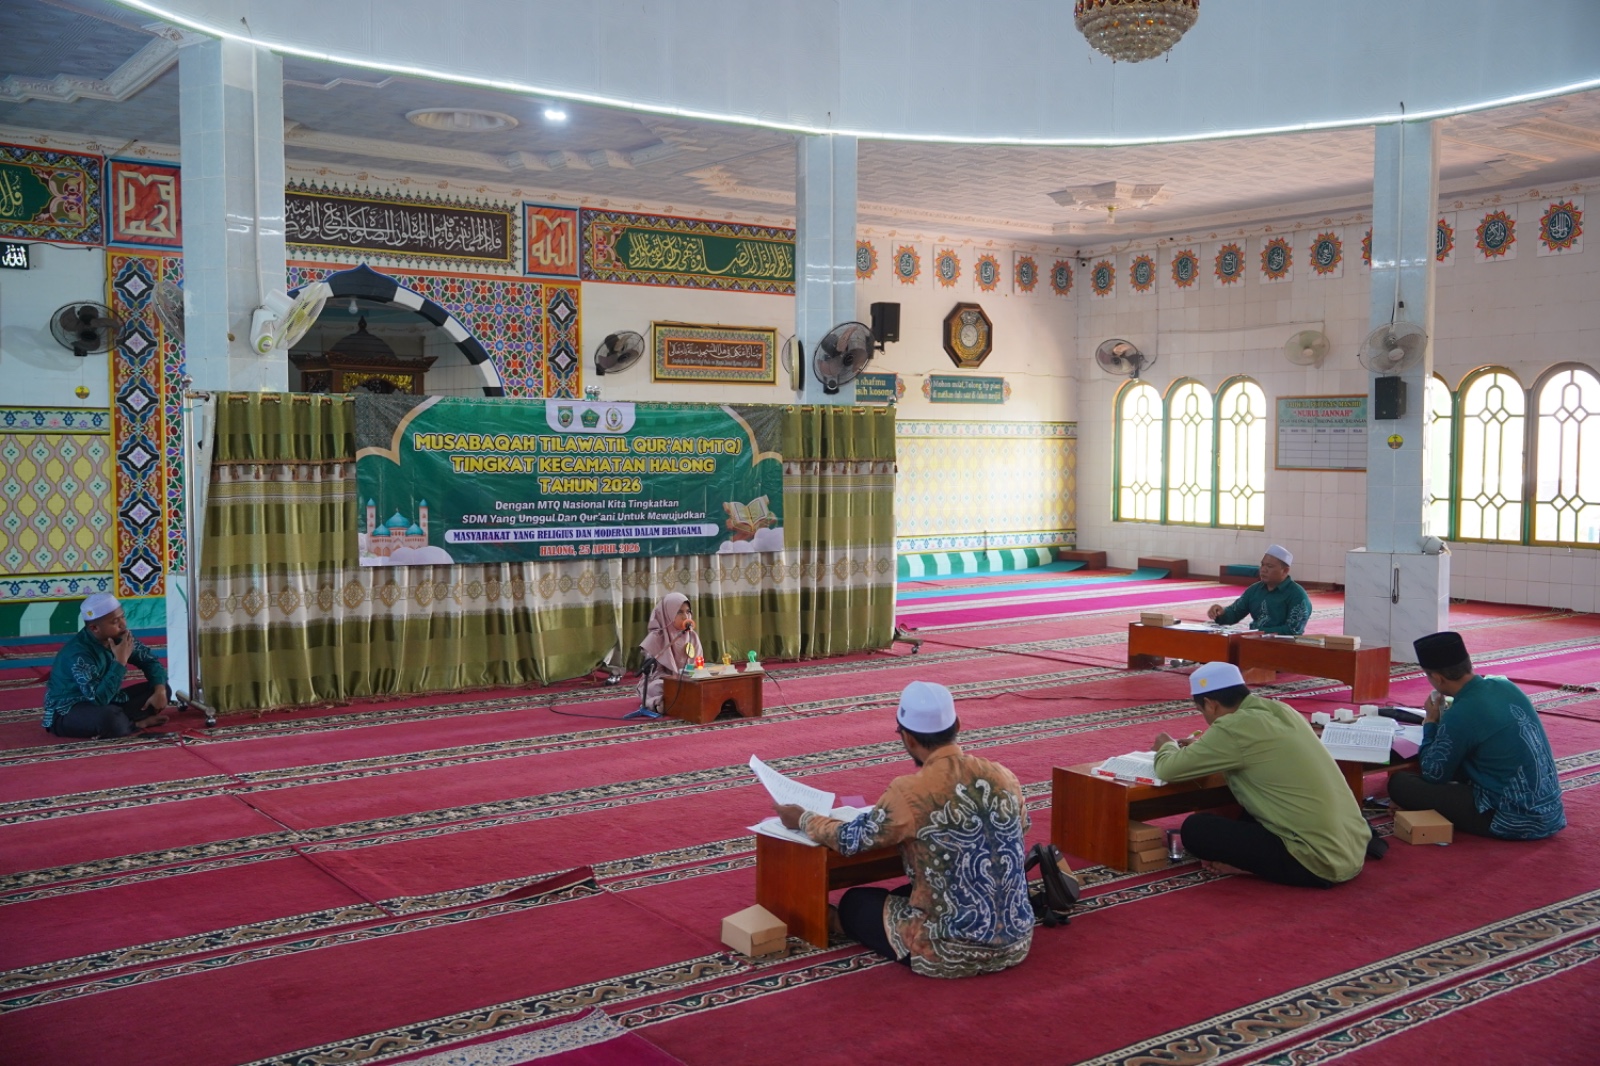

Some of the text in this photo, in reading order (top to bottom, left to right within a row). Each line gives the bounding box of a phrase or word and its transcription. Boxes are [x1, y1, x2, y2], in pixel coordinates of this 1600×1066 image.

[414, 433, 537, 452] MUSABAQAH
[539, 435, 629, 453] TILAWATIL
[697, 437, 742, 455] (MTQ)
[451, 456, 716, 473] TINGKAT KECAMATAN HALONG
[538, 477, 642, 494] TAHUN 2026
[495, 499, 680, 511] Dengan MTQ Nasional Kita Tingkatkan
[462, 514, 488, 524] SDM
[490, 514, 516, 525] Yang
[518, 512, 556, 524] Unggul
[558, 513, 578, 522] Dan
[617, 512, 646, 521] Untuk
[647, 510, 706, 522] Mewujudkan
[454, 526, 703, 541] MASYARAKAT YANG RELIGIUS DAN MODERASI DALAM BERAGAMA
[540, 543, 640, 556] HALONG, 25 APRIL 2026
